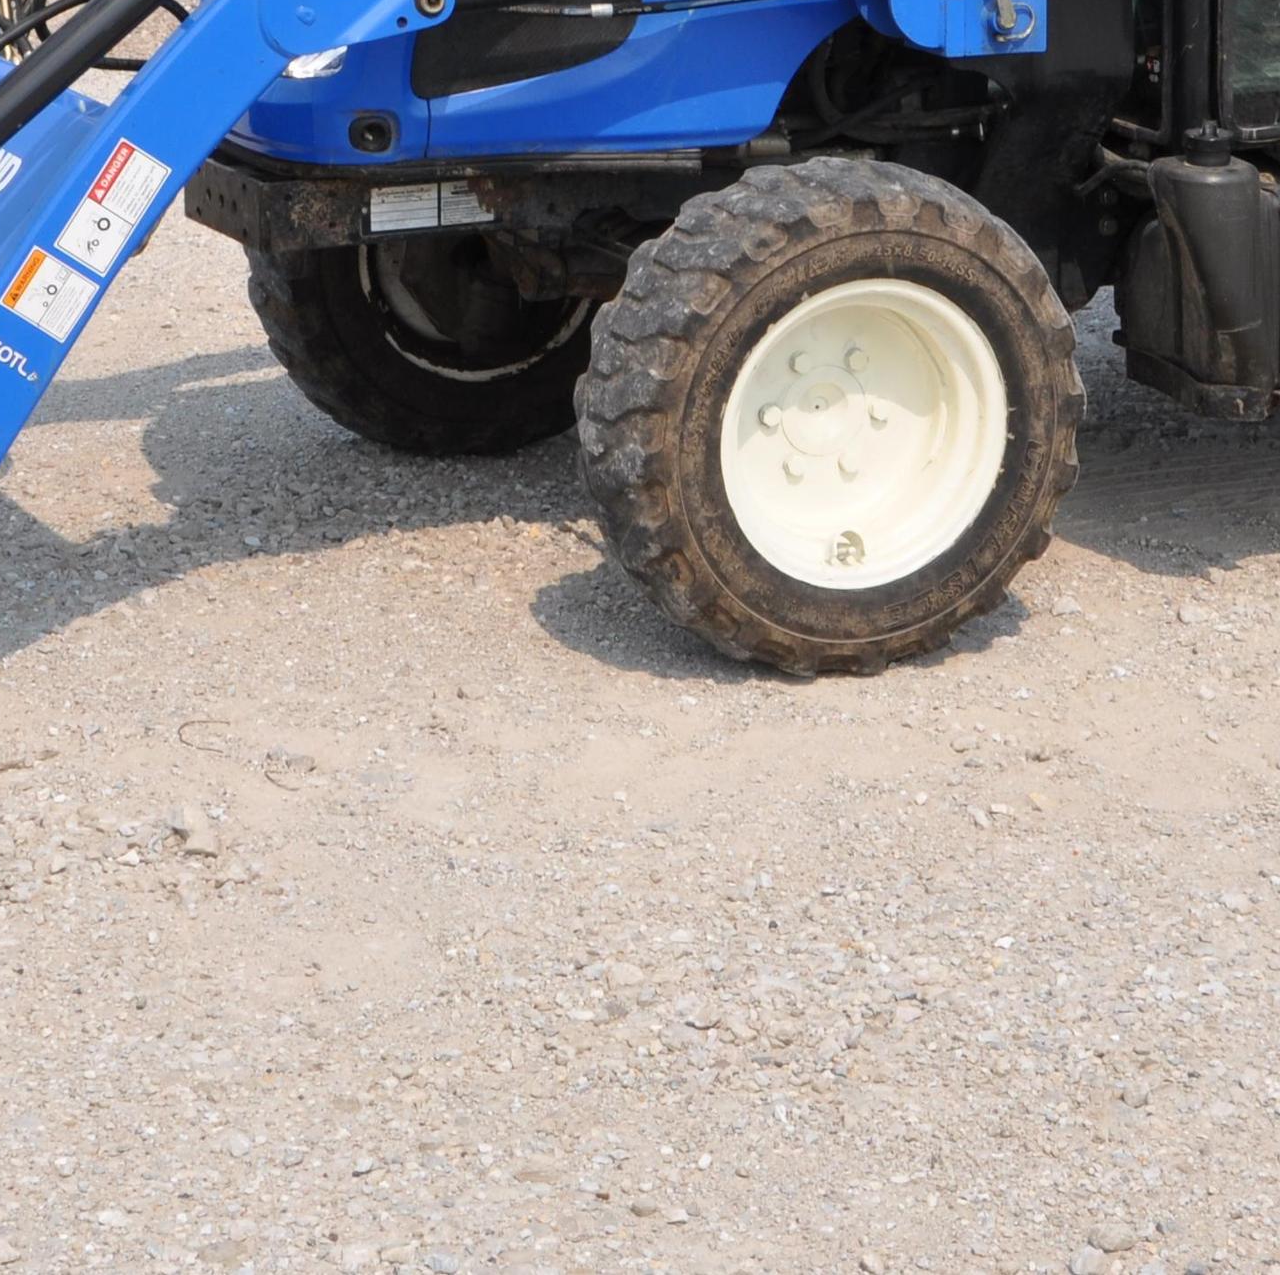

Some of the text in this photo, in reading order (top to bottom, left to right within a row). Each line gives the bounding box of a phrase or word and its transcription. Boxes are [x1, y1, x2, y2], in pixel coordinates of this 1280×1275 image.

[101, 147, 128, 188] DANGER
[14, 257, 41, 293] WARNING
[884, 439, 1046, 631] CARLISLE
